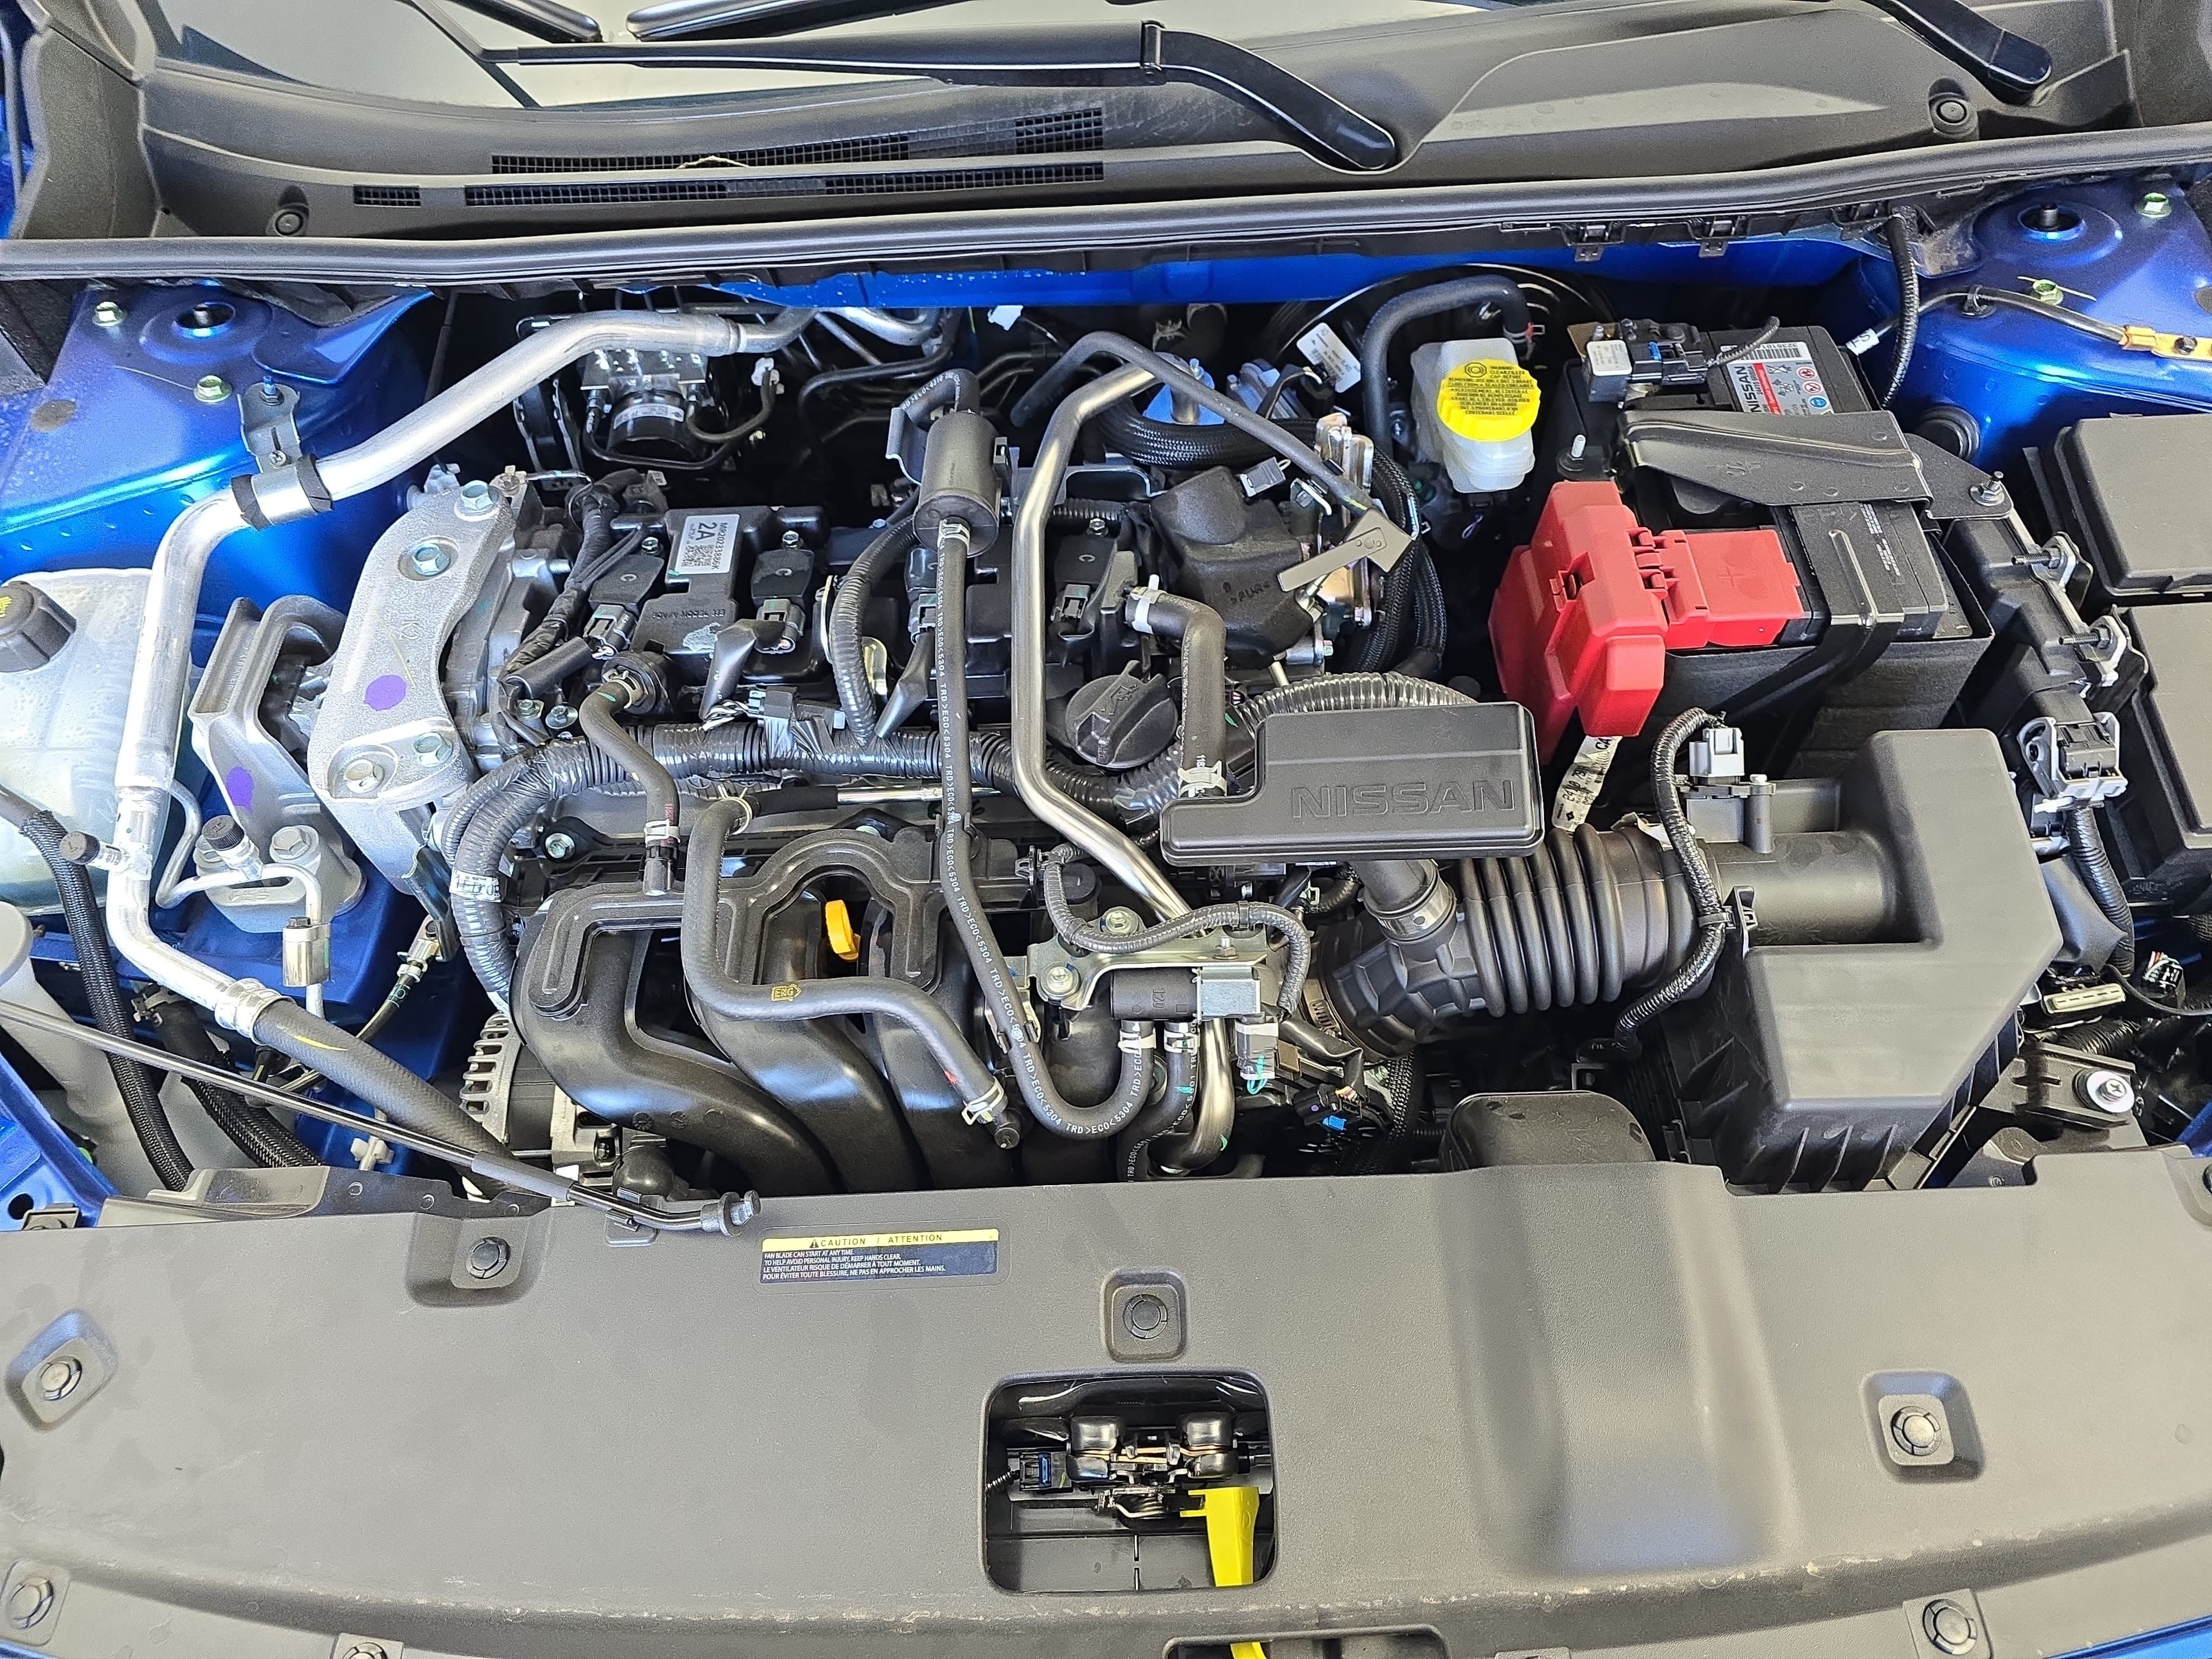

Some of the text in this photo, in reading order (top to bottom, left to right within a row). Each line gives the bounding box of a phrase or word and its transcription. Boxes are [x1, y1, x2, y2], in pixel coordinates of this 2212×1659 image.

[1734, 366, 1762, 413] NISSAN
[696, 522, 718, 541] 2A
[1196, 754, 1207, 768] 118
[1291, 780, 1516, 818] NISSAN
[774, 987, 794, 998] ENG
[1152, 987, 1166, 1008] 120
[821, 1238, 866, 1247] CAUTION
[888, 1234, 942, 1244] ATTENTION
[809, 1263, 831, 1271] RISQUE
[840, 1261, 871, 1269] DÉMARRER
[832, 1256, 851, 1264] INJURY,
[780, 1271, 800, 1279] ÉVITER
[820, 1269, 849, 1277] BLESSURE,
[879, 1265, 915, 1274] APPROCHER
[925, 1264, 946, 1272] MAINS.
